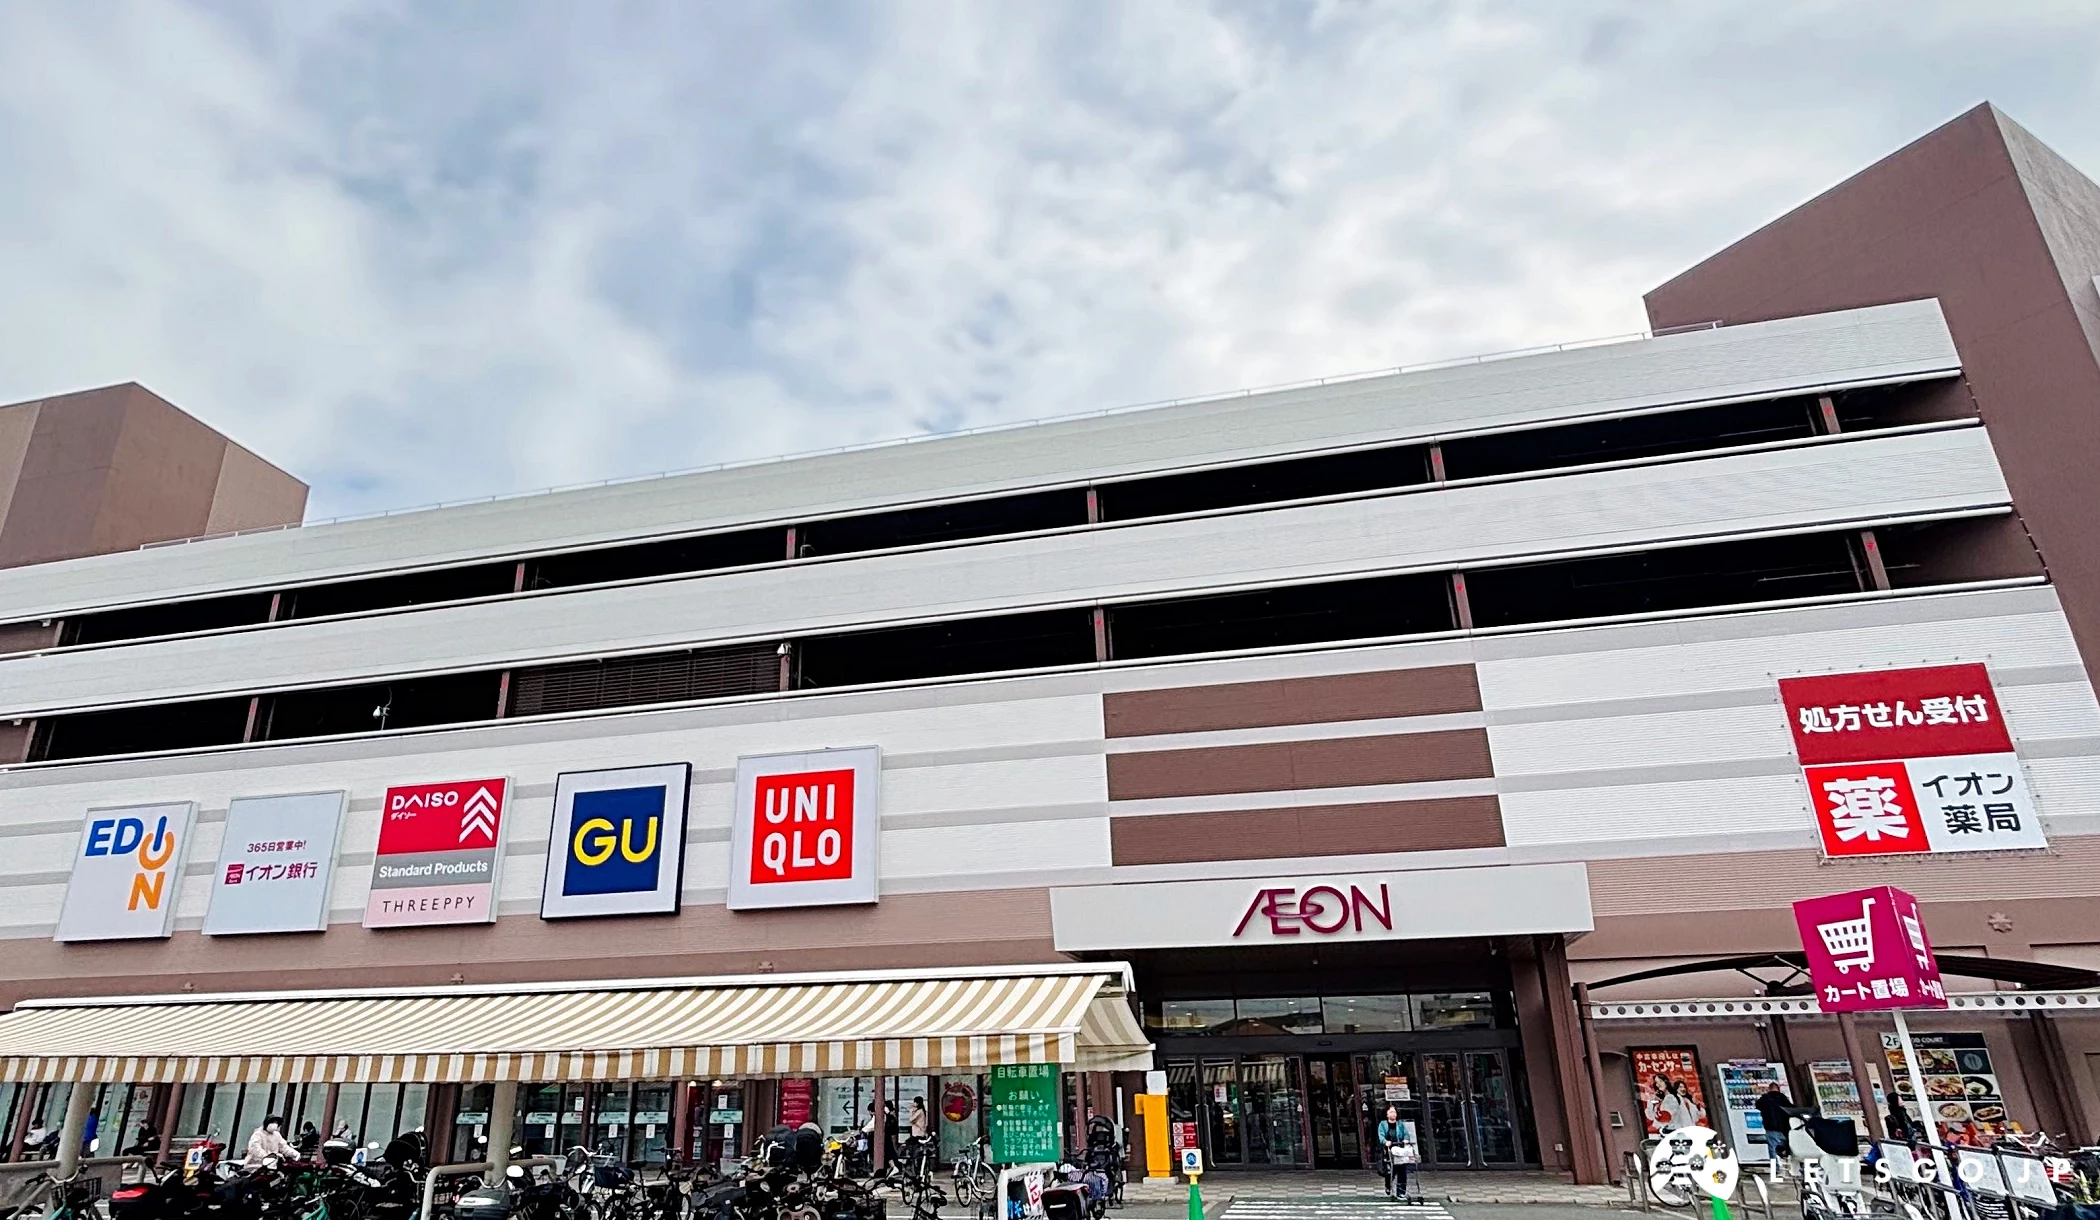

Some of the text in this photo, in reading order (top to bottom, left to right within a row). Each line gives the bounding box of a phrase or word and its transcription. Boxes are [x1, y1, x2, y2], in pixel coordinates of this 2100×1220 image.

[1799, 694, 1989, 735] 処方せん受付
[1922, 772, 2013, 798] イオン
[391, 791, 459, 811] DAISO
[765, 783, 835, 824] UNI
[1822, 776, 1910, 842] 薬
[1941, 802, 2021, 835] 薬局
[573, 815, 658, 867] GU
[762, 828, 841, 876] QLO
[245, 861, 318, 881] イオン銀行
[379, 860, 488, 878] Standard Products
[383, 896, 475, 913] THREEPPY
[1823, 977, 1910, 1003] カート置場
[1884, 1035, 1900, 1047] 2F
[997, 1065, 1050, 1079] 自転車置場
[1638, 1061, 1681, 1073] カーセンサー
